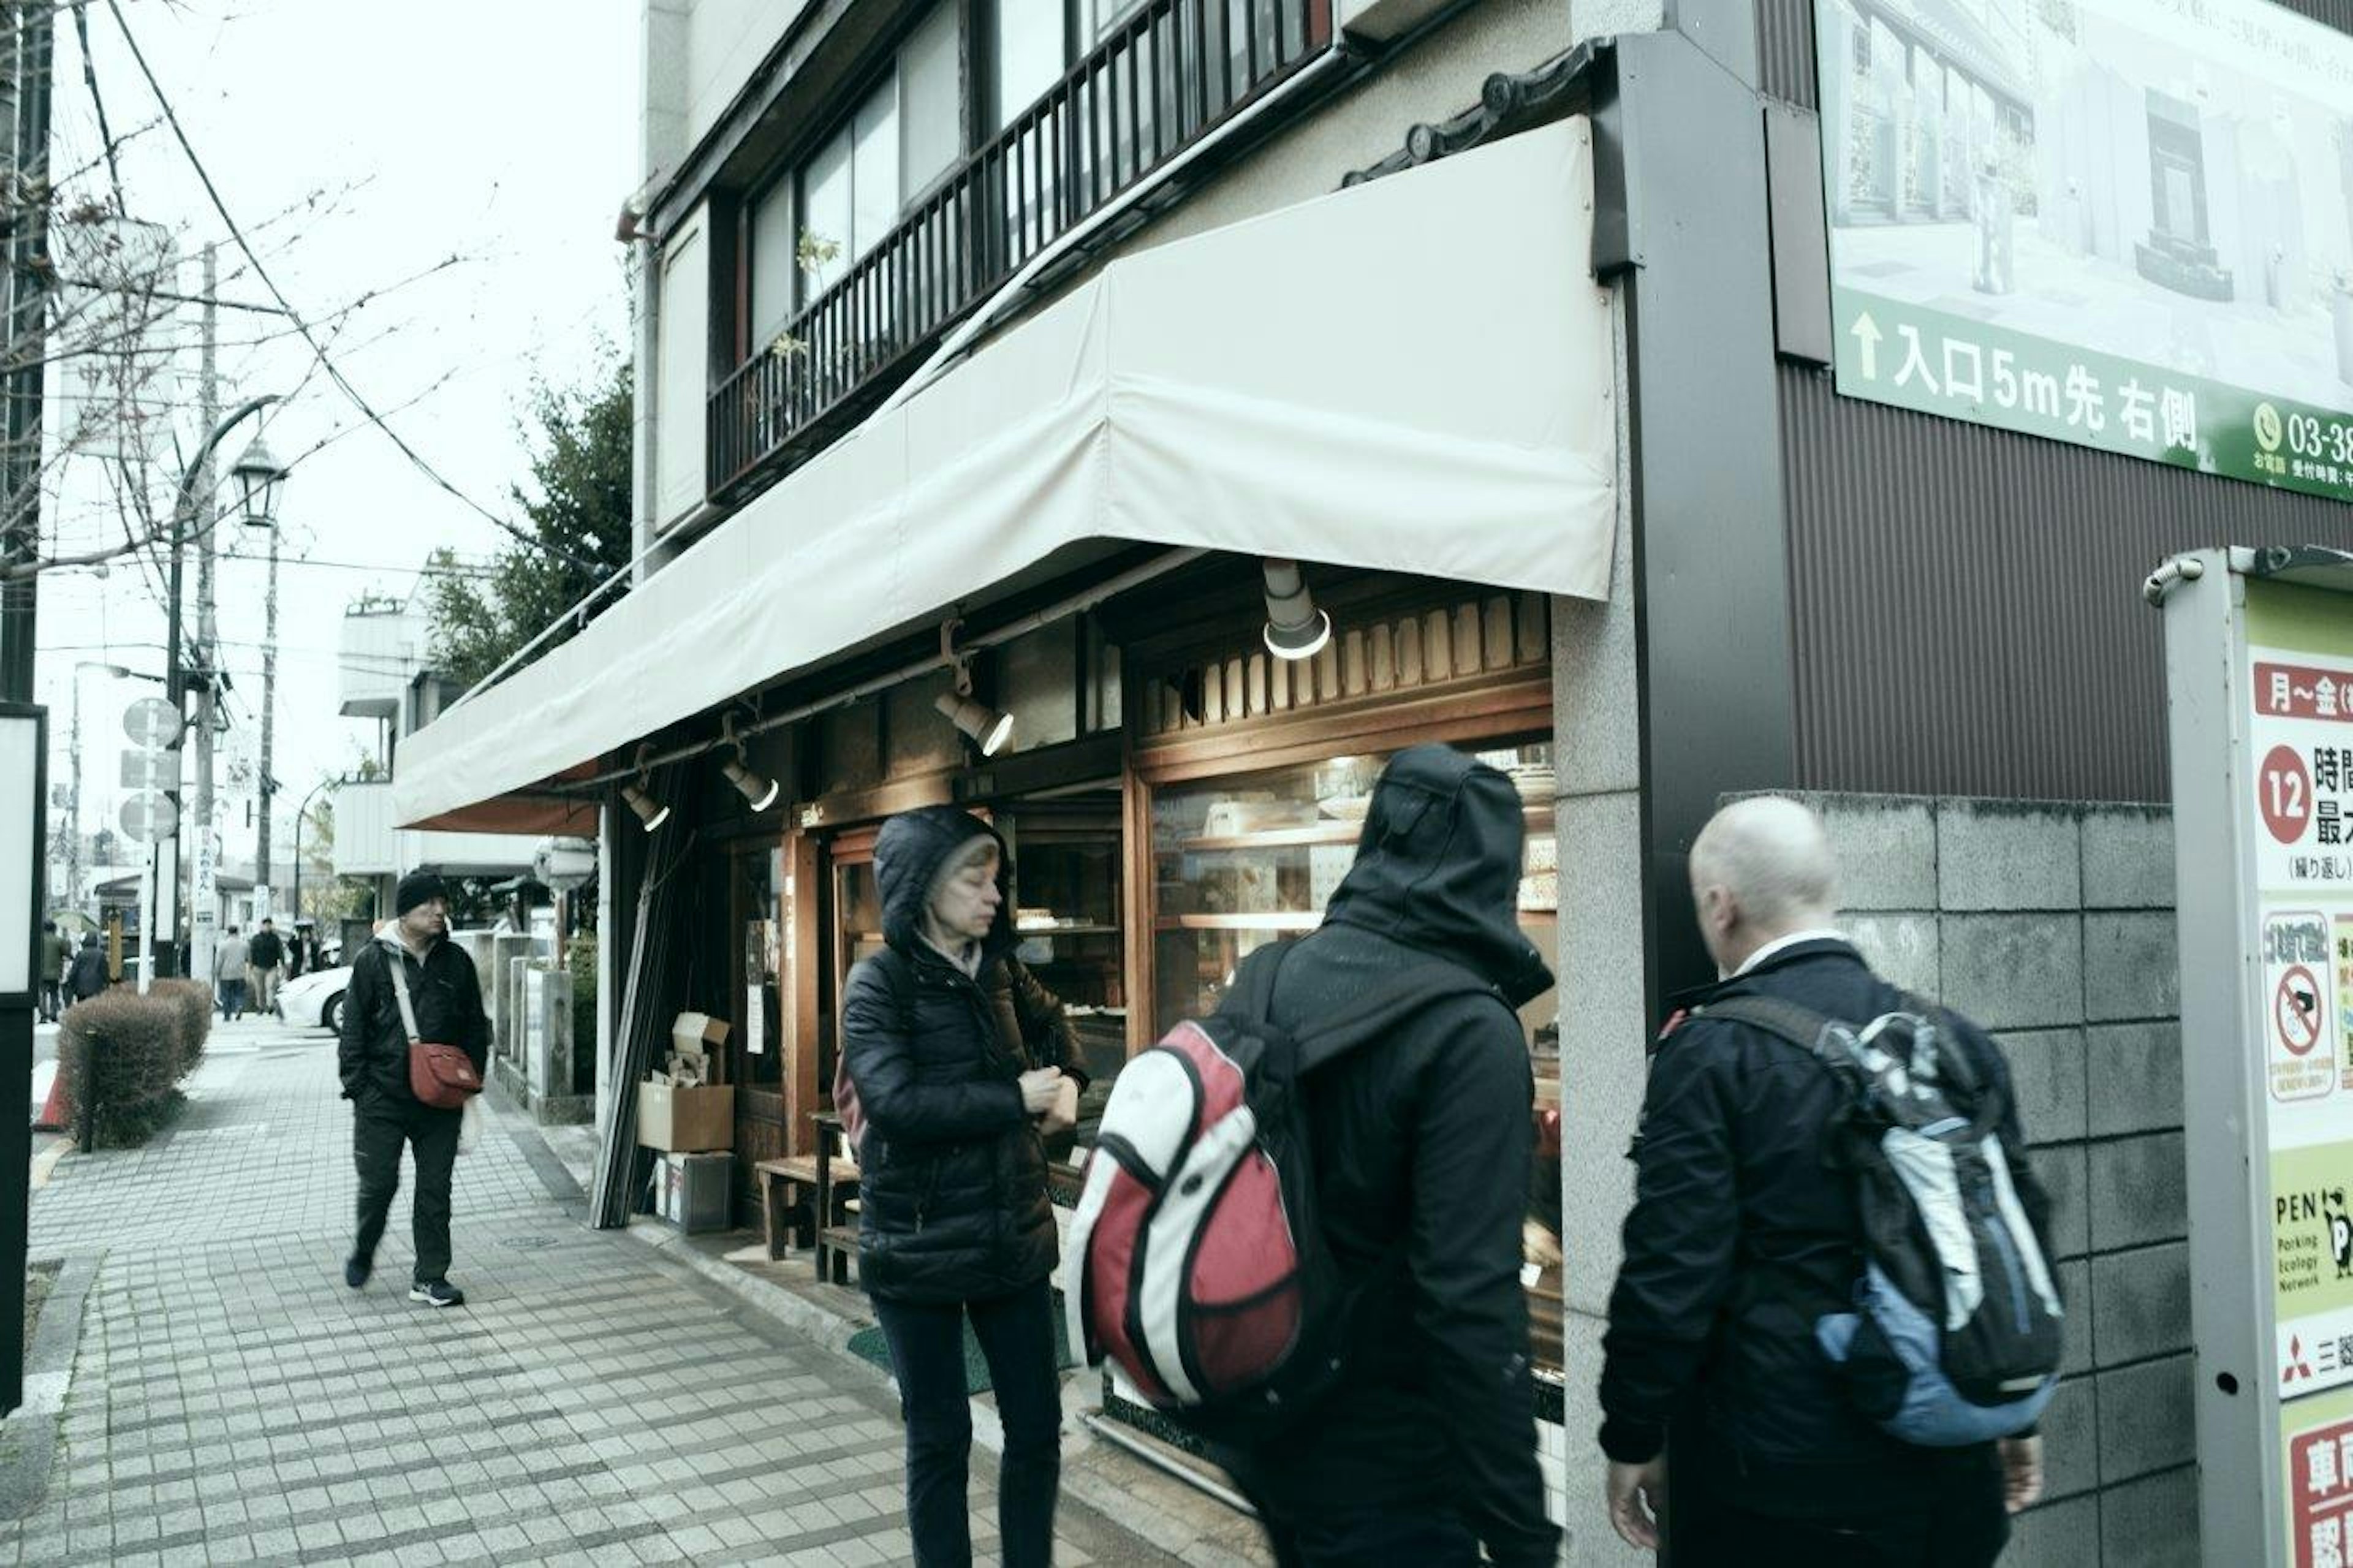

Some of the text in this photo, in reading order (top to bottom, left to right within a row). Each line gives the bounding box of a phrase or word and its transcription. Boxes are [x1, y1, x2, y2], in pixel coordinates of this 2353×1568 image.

[1894, 324, 2197, 450] 入口5m先 右側
[2268, 770, 2304, 818] 12
[2277, 1192, 2316, 1224] PEN
[2278, 1235, 2317, 1253] Parking
[2279, 1257, 2317, 1274] Ecology
[2279, 1274, 2319, 1293] Network
